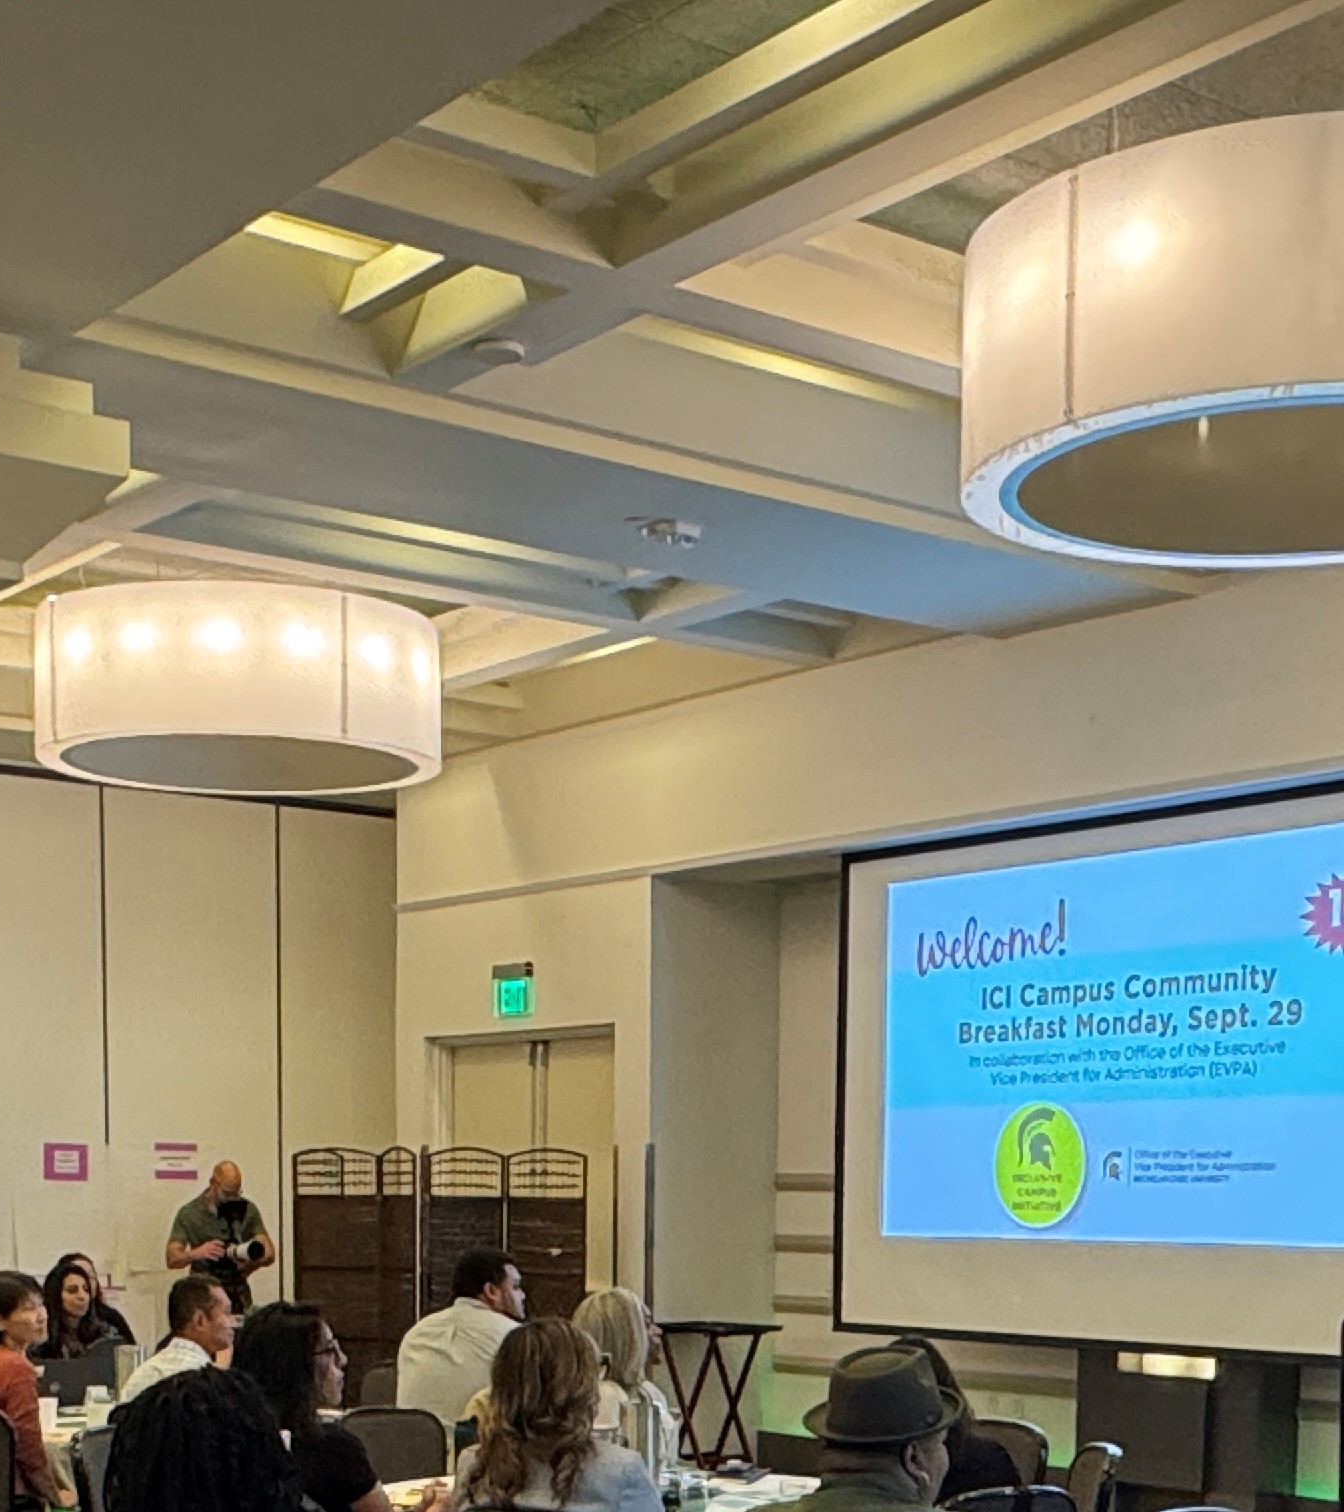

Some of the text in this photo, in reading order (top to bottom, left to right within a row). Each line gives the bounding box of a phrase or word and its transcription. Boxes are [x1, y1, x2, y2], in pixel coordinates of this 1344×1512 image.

[917, 898, 1066, 977] Welcome!
[981, 964, 1277, 1010] ICI Campus Community
[959, 999, 1302, 1044] Breakfast Monday, Sept. 29
[983, 1050, 1066, 1068] collaboration
[1068, 1048, 1096, 1063] with
[1124, 1044, 1166, 1061] Office
[1169, 1042, 1184, 1059] of
[1187, 1042, 1211, 1058] the
[1214, 1039, 1286, 1056] Executive
[990, 1060, 1257, 1085] Vice President for Administration (EVPA)
